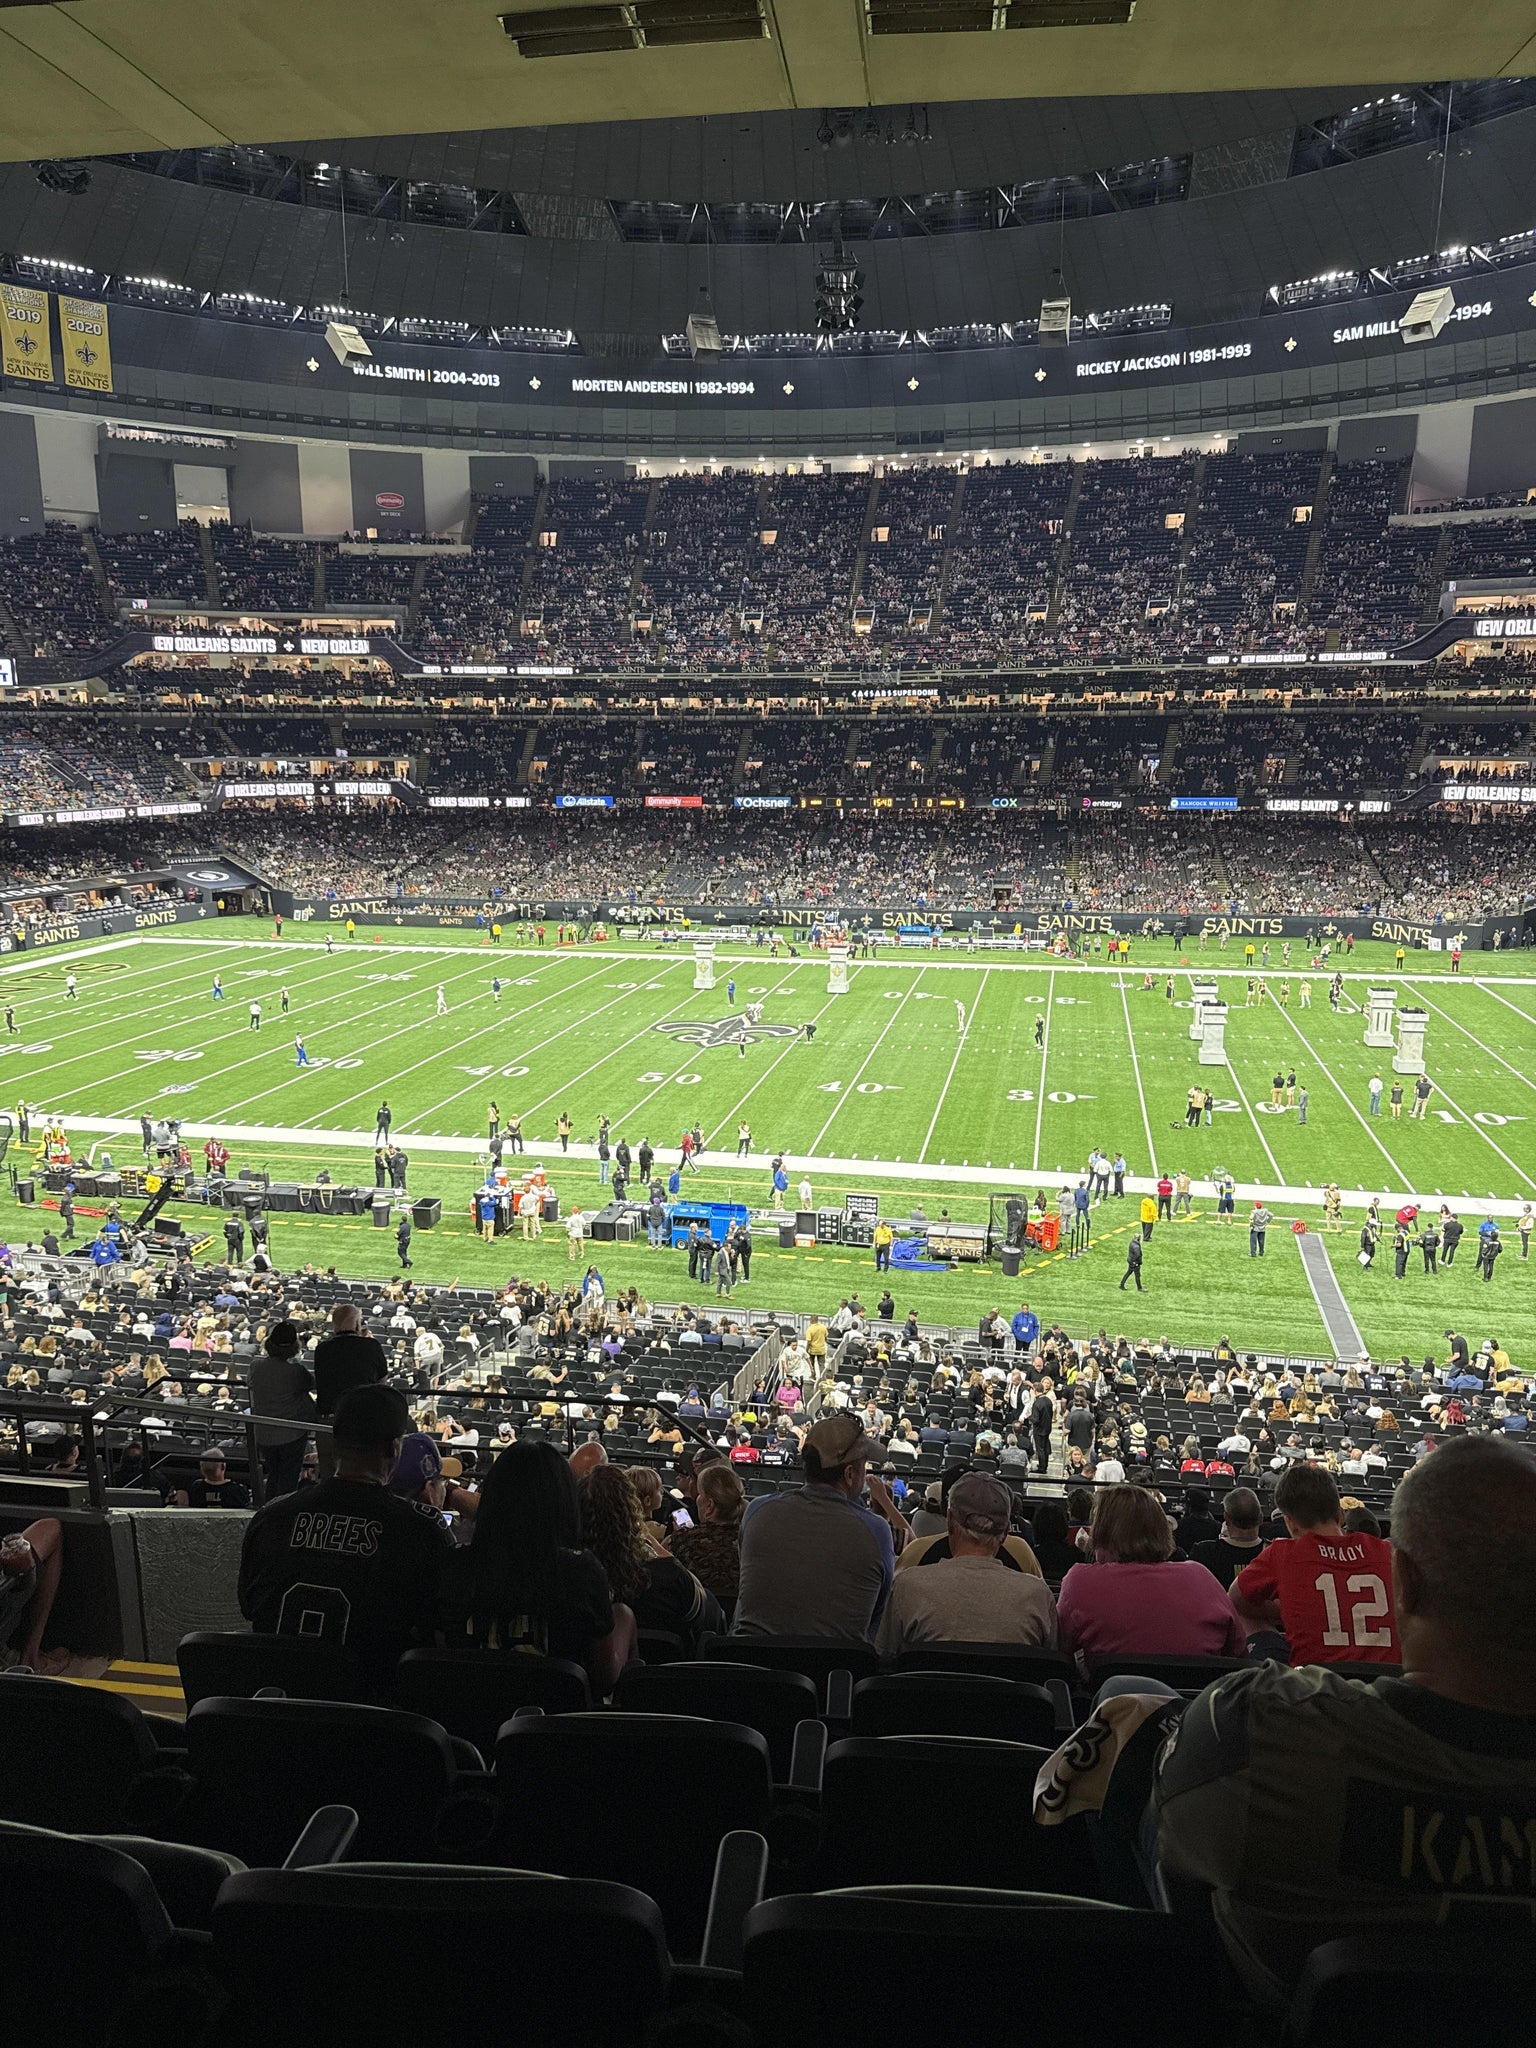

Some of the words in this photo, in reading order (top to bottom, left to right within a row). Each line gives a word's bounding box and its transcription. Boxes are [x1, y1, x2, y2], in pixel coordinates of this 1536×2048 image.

[7, 307, 41, 324] 2019
[64, 306, 104, 319] CHAMPIONS
[68, 318, 102, 336] 2020
[1333, 325, 1364, 343] SAM
[1076, 360, 1121, 377] RICKEY
[1122, 352, 1180, 372] JACKSON
[1189, 343, 1252, 364] 1981-1993
[7, 364, 50, 379] SAINTS
[385, 366, 425, 382] SMITH
[433, 370, 500, 387] 2004-2013
[68, 375, 109, 390] SAINTS
[572, 379, 623, 393] MORTEN
[625, 380, 688, 394] ANDERSEN
[695, 382, 755, 395] 1982-1994
[175, 637, 230, 652] ORLEANS
[231, 638, 277, 653] SAINTS
[301, 640, 329, 654] NEW
[932, 662, 961, 670] SAINTS
[997, 661, 1026, 669] SAINTS
[1063, 659, 1093, 667] SAINTS
[1131, 657, 1163, 665] SAINTS
[1150, 683, 1178, 691] SAINTS
[1215, 682, 1245, 690] SAINTS
[1283, 681, 1315, 689] SAINTS
[1354, 680, 1386, 688] SAINTS
[1426, 678, 1459, 687] SAINTS
[1500, 677, 1533, 685] SAINTS
[154, 685, 180, 694] SAINTS
[214, 687, 241, 695] SAINTS
[275, 688, 302, 696] SAINTS
[515, 690, 541, 698] SAINTS
[574, 690, 600, 698] SAINTS
[893, 689, 938, 697] SUPERDOME
[234, 783, 275, 797] ORLEANS
[276, 783, 315, 796] SAINTS
[335, 783, 358, 795] NEW
[1441, 786, 1466, 800] NEW
[1467, 786, 1520, 801] ORLEANS
[458, 797, 489, 807] SAINTS
[506, 797, 525, 807] NEW
[648, 796, 682, 807] Community
[743, 797, 789, 808] Ochsner
[992, 798, 1018, 807] COX
[1092, 800, 1122, 809] entergy
[1301, 801, 1338, 812] SAINTS
[1359, 801, 1383, 813] NEW
[329, 899, 388, 918] SAINTS
[135, 910, 177, 928] SAINTS
[439, 917, 463, 925] SAINTS
[882, 911, 953, 927] SAINTS
[1038, 914, 1112, 931] SAINTS
[1203, 917, 1283, 935] SAINTS
[34, 925, 80, 945] SAINTS
[1371, 921, 1432, 945] SAINTS
[464, 1065, 530, 1077] 40
[637, 1072, 702, 1085] 50
[817, 1081, 884, 1094] 40
[1006, 1089, 1076, 1103] 30
[1211, 1099, 1287, 1114] 20
[1431, 1110, 1508, 1125] 10
[1296, 1222, 1306, 1232] 20
[950, 1247, 982, 1258] SAINTS
[290, 1512, 383, 1557] BREES
[1318, 1543, 1366, 1562] BRADY
[1315, 1573, 1392, 1648] 12
